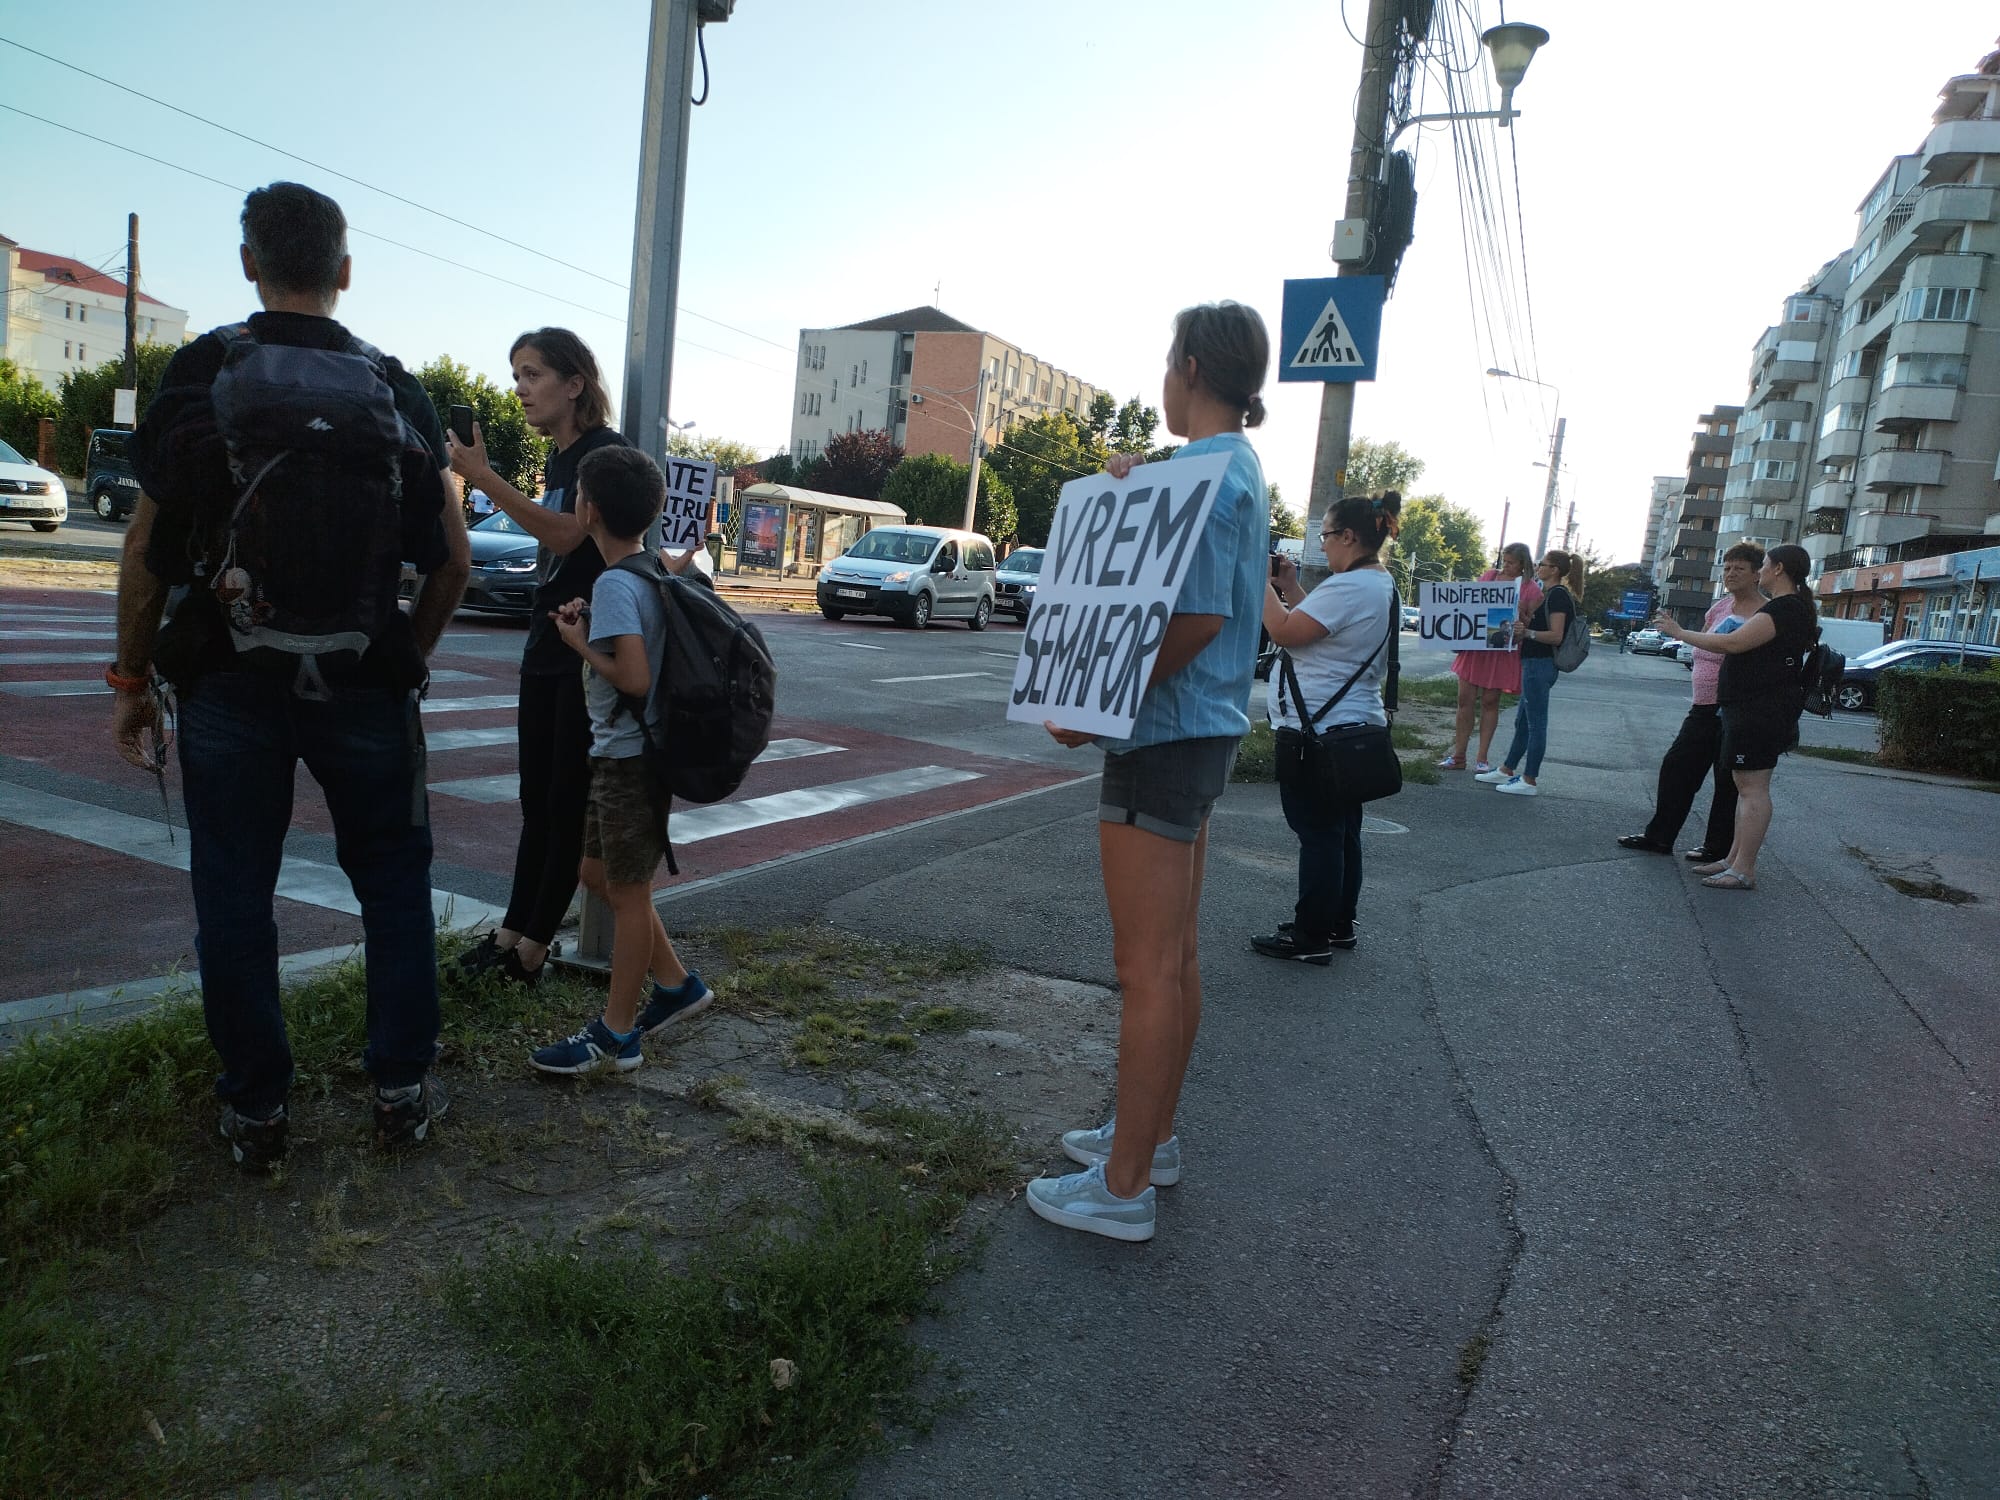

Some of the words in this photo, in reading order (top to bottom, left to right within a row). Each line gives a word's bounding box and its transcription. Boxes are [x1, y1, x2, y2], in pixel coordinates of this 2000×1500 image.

[663, 496, 709, 520] TRU
[1054, 480, 1212, 587] VREM
[1421, 609, 1487, 640] UCIDE
[1013, 601, 1168, 719] SEMAFOR
